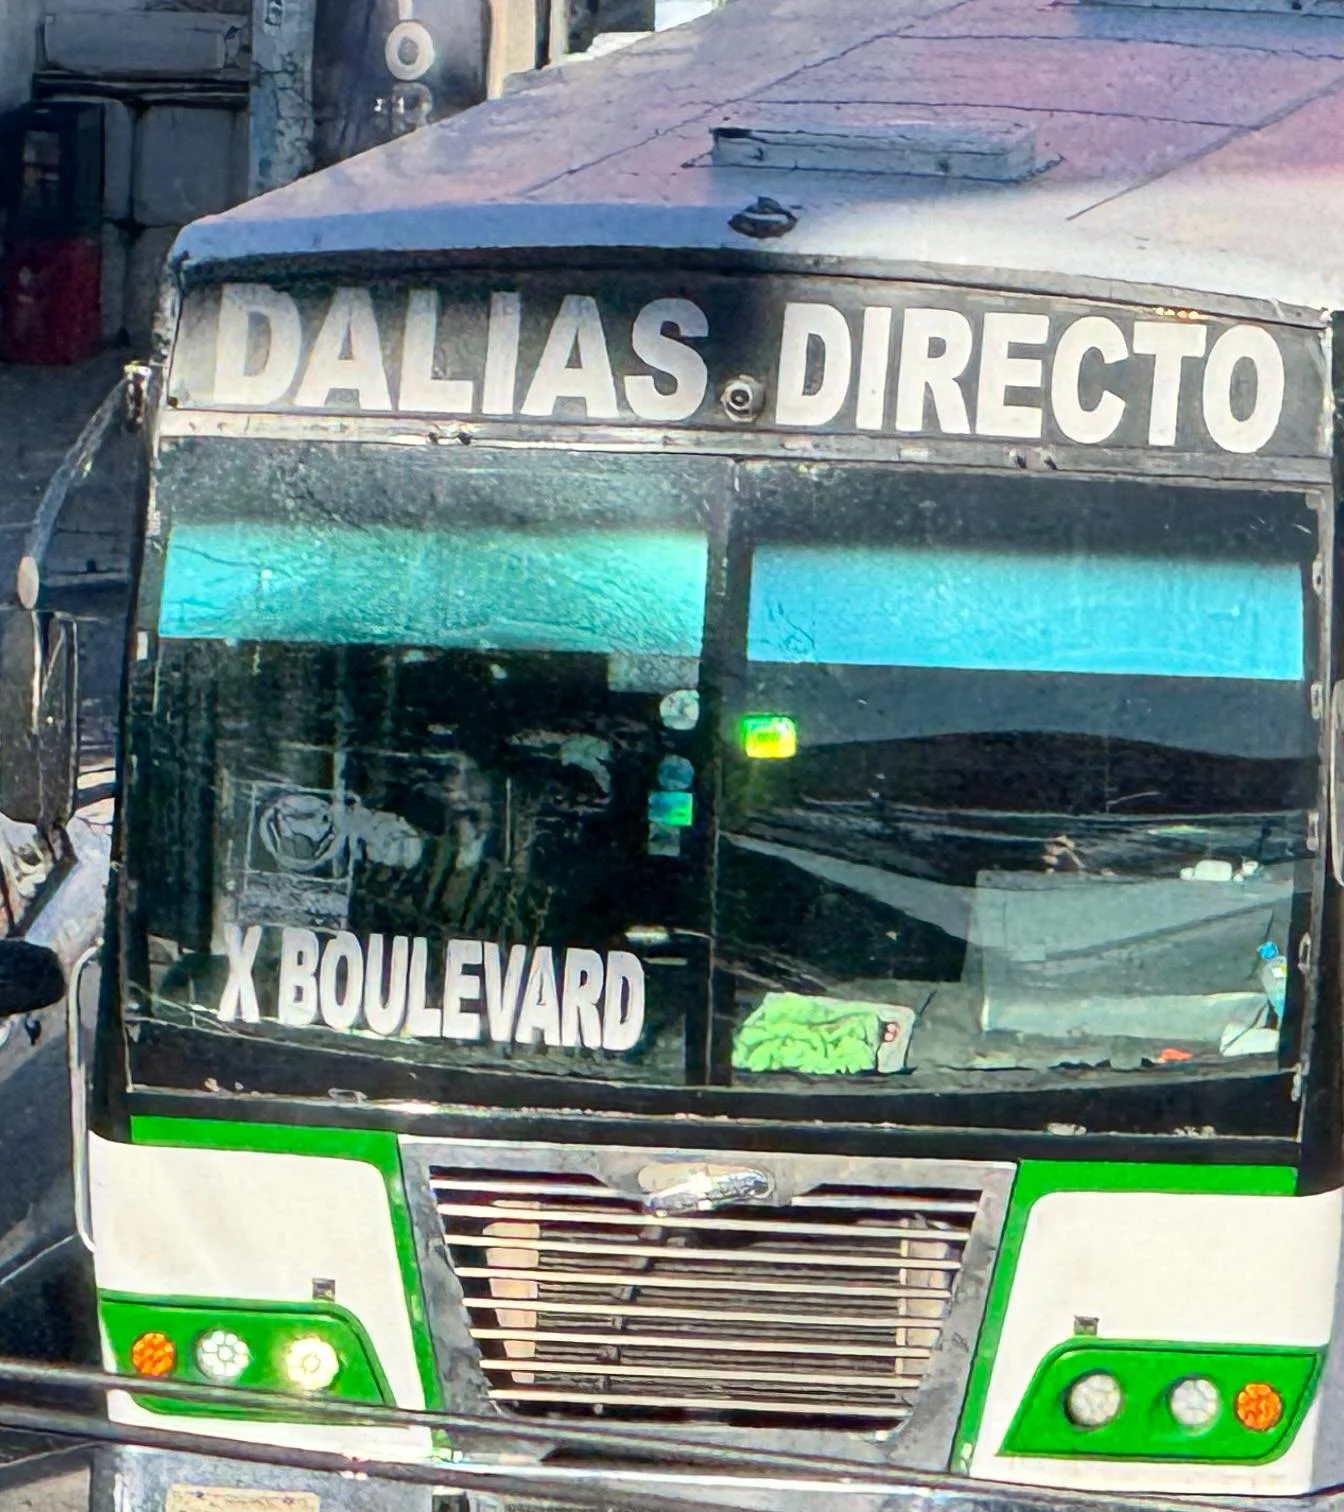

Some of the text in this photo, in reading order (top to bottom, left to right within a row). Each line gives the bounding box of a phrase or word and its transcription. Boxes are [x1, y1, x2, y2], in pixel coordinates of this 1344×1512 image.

[212, 283, 1285, 453] DALIAS DIRECTO
[218, 924, 645, 1051] X BOULEVARD
